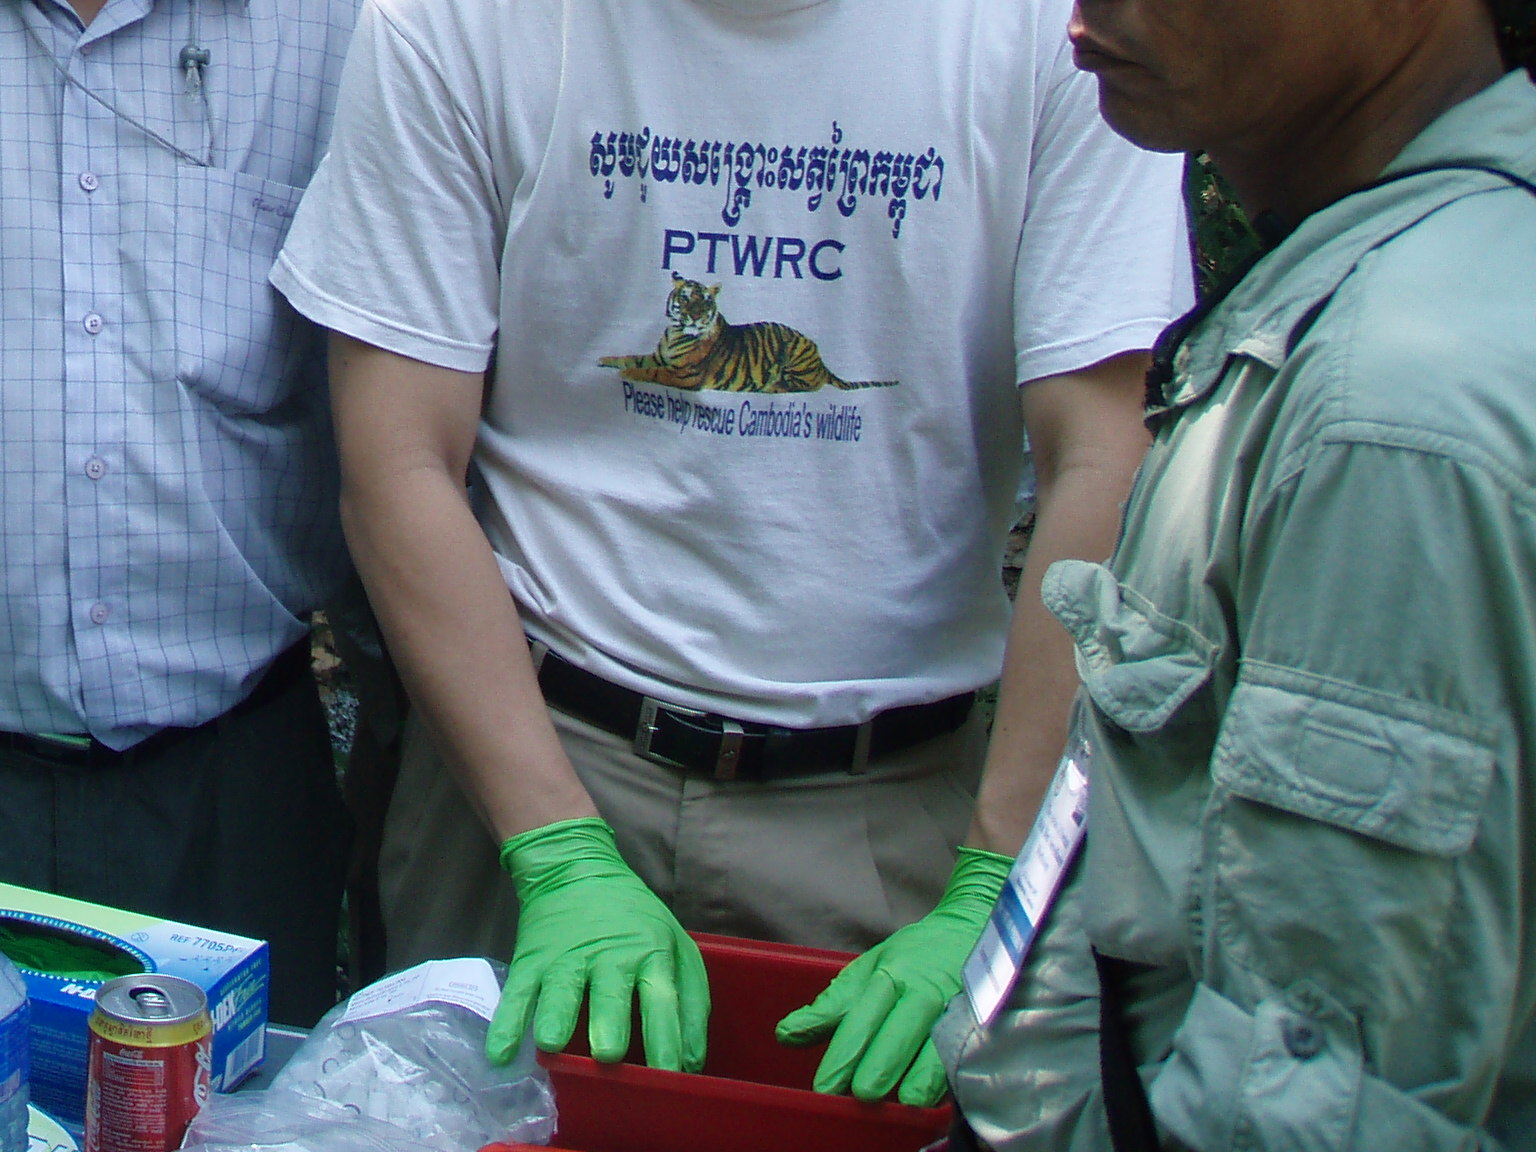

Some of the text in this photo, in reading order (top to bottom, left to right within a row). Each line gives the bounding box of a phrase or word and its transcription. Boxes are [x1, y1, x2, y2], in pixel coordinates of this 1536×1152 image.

[661, 228, 846, 281] PTWRC
[622, 380, 862, 442] Please help rescue Cambodia's wildlife
[170, 933, 192, 945] REF
[60, 982, 97, 1000] N-D
